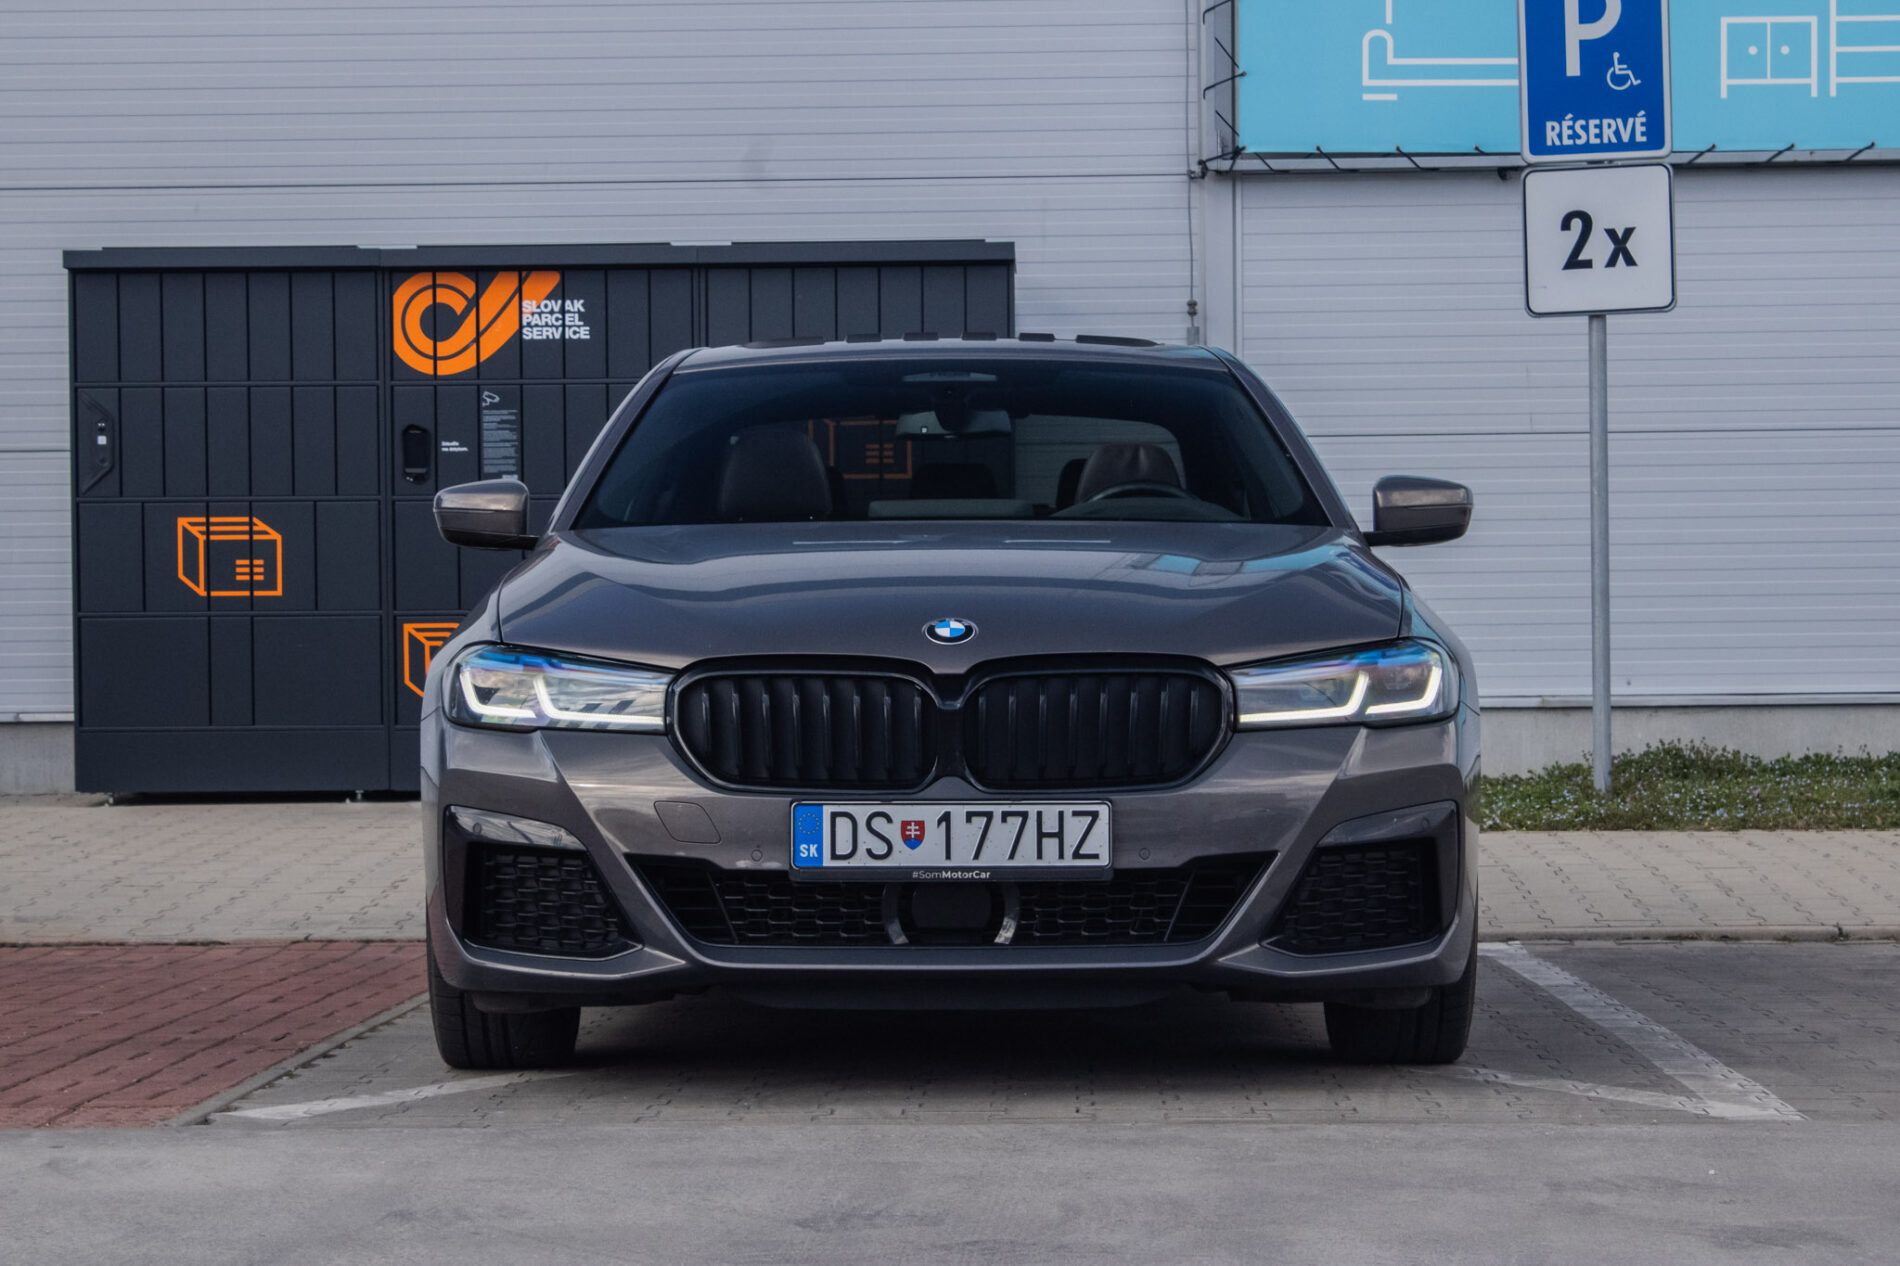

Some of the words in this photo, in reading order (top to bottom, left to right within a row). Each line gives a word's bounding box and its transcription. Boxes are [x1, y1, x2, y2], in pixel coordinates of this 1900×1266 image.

[1564, 0, 1622, 76] P
[1545, 110, 1647, 146] RÉSERVÉ
[522, 299, 585, 312] SLOVAK
[522, 313, 584, 326] PARCEL
[522, 326, 590, 339] SERVICE
[830, 811, 894, 861] DS
[937, 810, 1100, 861] 177HZ
[799, 844, 818, 858] SK
[912, 870, 990, 879] #SomMotorCar
